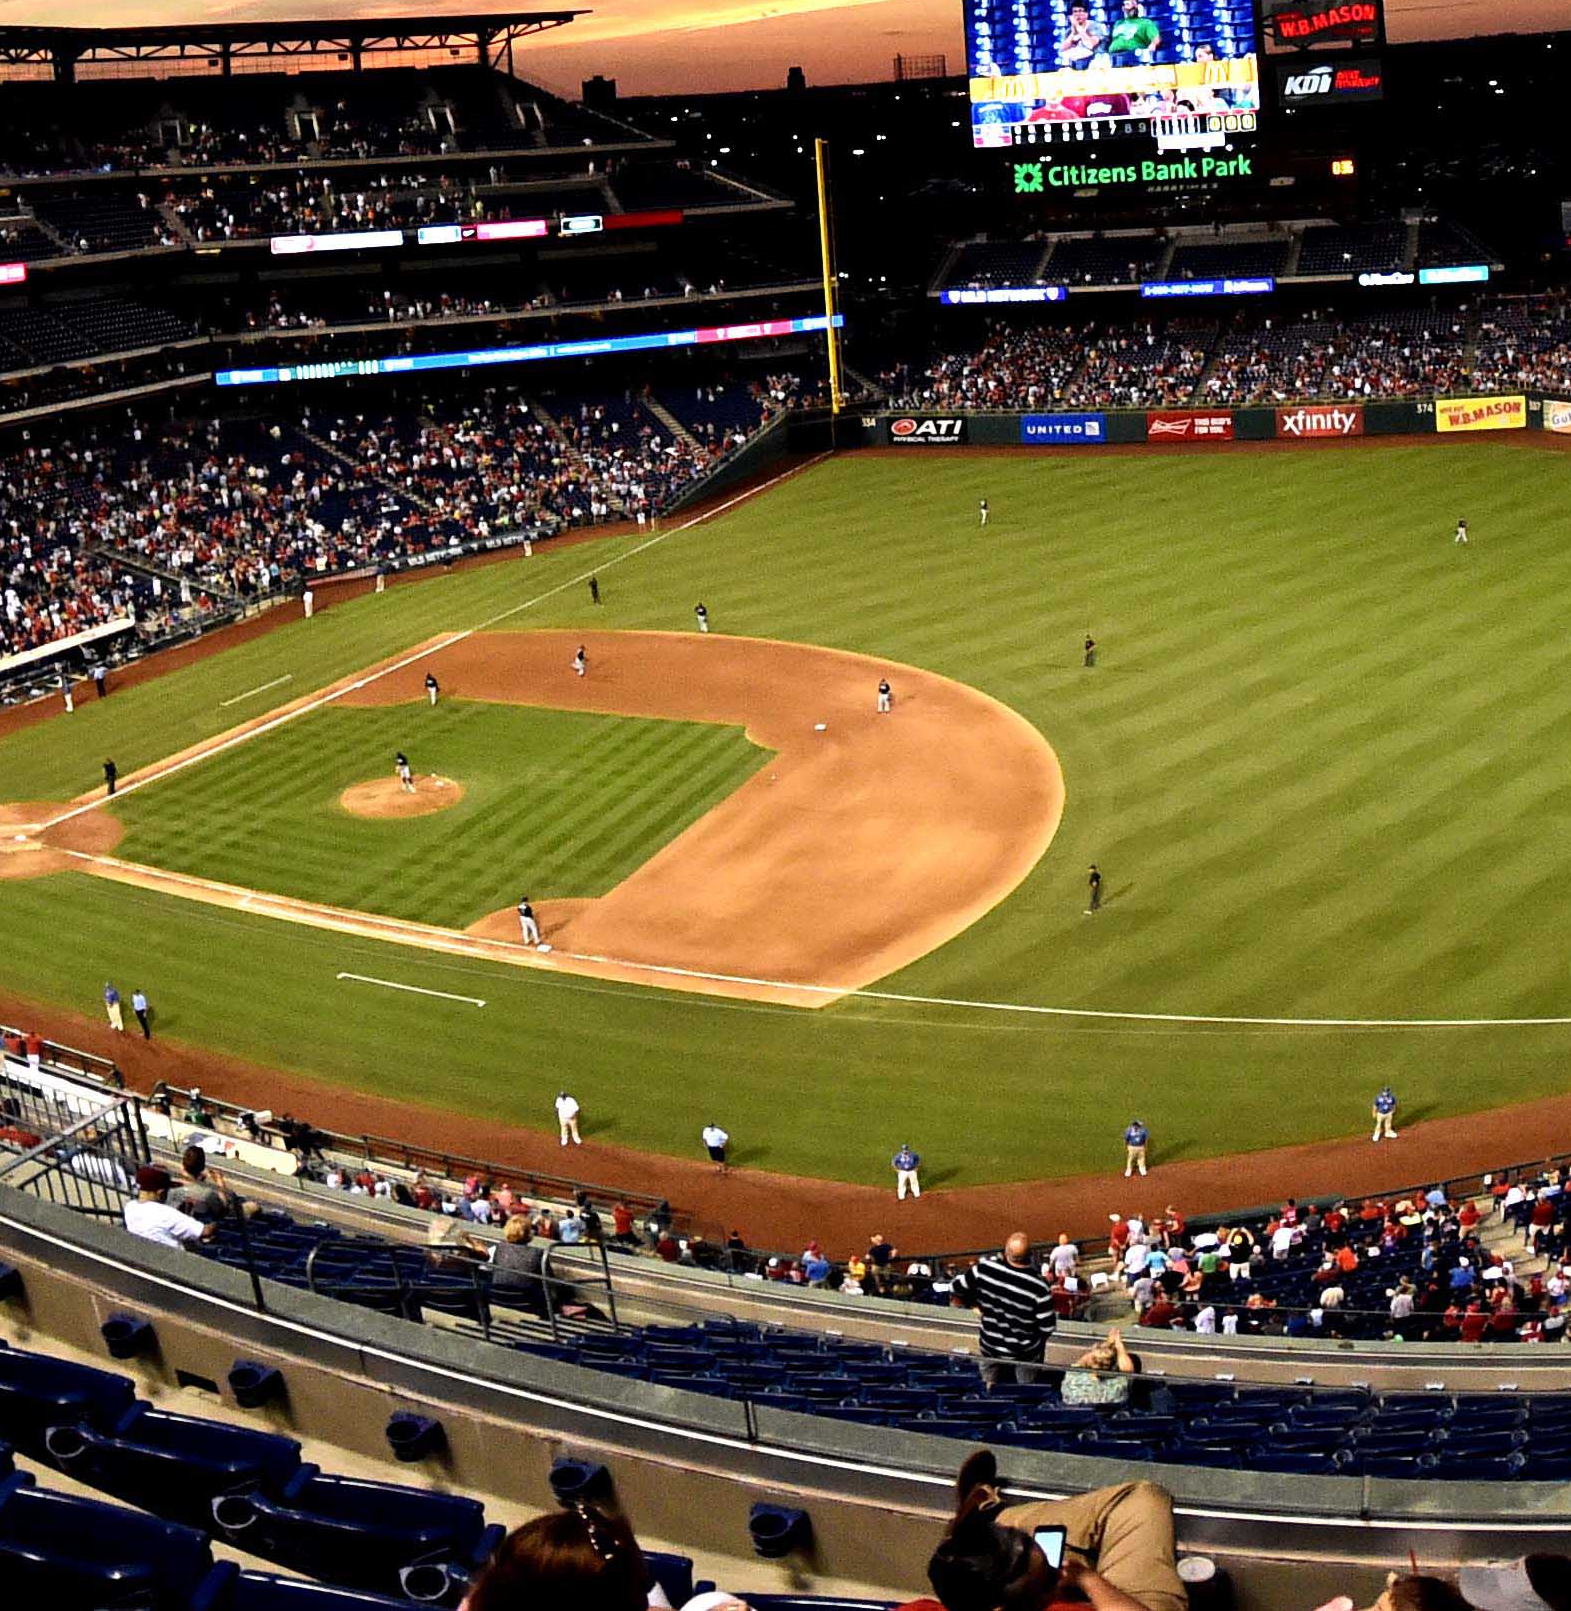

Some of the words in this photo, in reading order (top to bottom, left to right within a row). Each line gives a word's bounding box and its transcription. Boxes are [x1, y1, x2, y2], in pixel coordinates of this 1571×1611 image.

[1048, 162, 1135, 186] Citizens
[1141, 158, 1197, 181] Bank
[1202, 154, 1252, 176] Park
[916, 419, 962, 435] ATI
[1027, 426, 1082, 434] UNITED
[1283, 409, 1356, 436] xfinity
